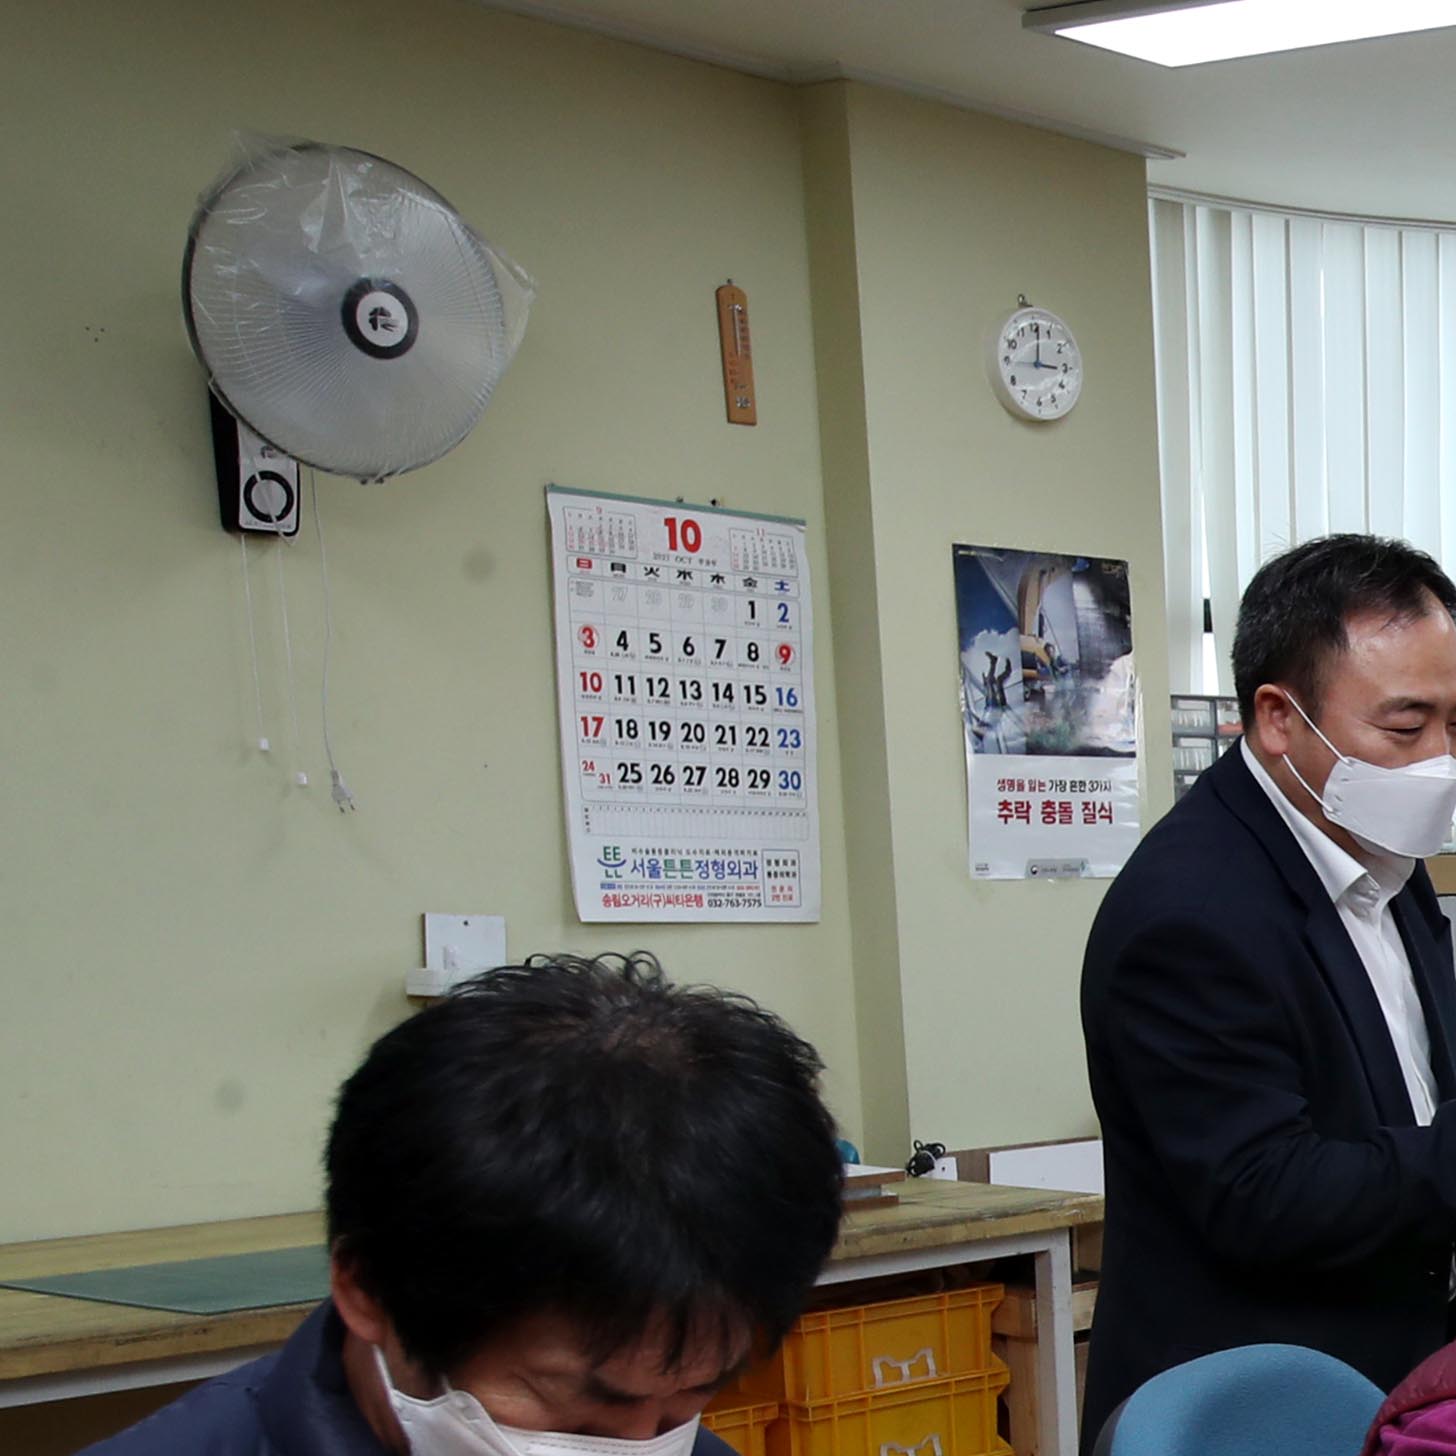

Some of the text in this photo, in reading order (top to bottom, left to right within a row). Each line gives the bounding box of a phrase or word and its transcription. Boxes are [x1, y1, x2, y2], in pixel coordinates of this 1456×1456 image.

[664, 517, 702, 554] 10
[644, 566, 660, 577] 火
[676, 569, 693, 580] 水
[710, 573, 726, 584] 木
[774, 579, 790, 592] 土
[748, 600, 789, 623] 1 2
[582, 626, 791, 665] 3 4 5 6 7 8 9
[579, 671, 603, 693] 10
[614, 674, 635, 696] 11
[646, 677, 670, 698] 12
[679, 679, 702, 701] 13
[712, 682, 734, 703] 14
[743, 684, 767, 705] 15
[775, 687, 798, 708] 16
[580, 715, 801, 749] 17 18 19 20 21 22 23
[581, 760, 802, 791] 24 25 26 27 28 29 30
[599, 772, 611, 785] 31
[1048, 779, 1067, 792] 가장
[997, 799, 1113, 824] 추락 충돌 질식
[631, 857, 758, 880] 서울튼튼정형외과
[707, 899, 762, 908] 032-763-7575
